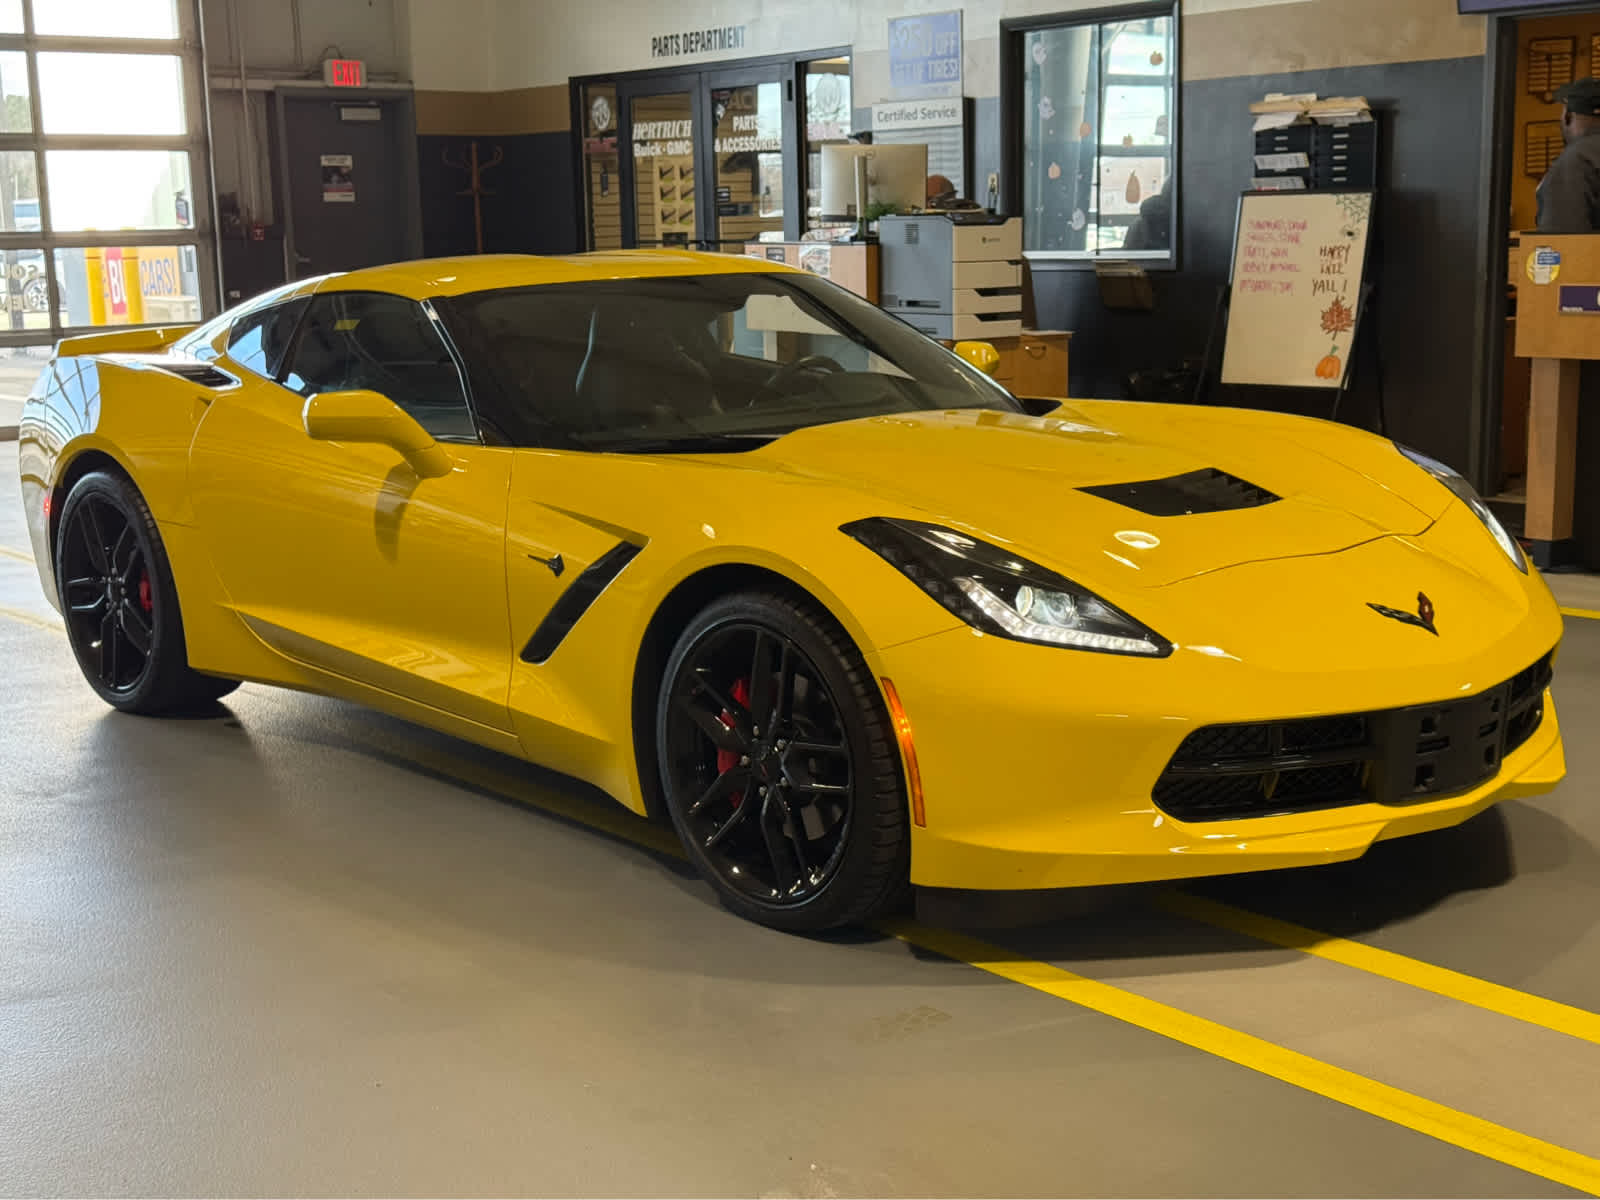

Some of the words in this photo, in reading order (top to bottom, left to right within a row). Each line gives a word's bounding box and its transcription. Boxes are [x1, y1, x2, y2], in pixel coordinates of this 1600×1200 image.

[651, 33, 680, 57] PARTS
[682, 25, 746, 54] DEPARTMENT
[332, 60, 362, 87] EXIT
[877, 107, 918, 122] Certified
[920, 104, 957, 120] Service
[732, 114, 760, 132] PARTS
[633, 141, 662, 157] Buick
[666, 139, 691, 155] GMC
[722, 136, 782, 153] ACCESSORIES
[1319, 244, 1351, 264] HAPPY
[141, 258, 178, 297] CARS!
